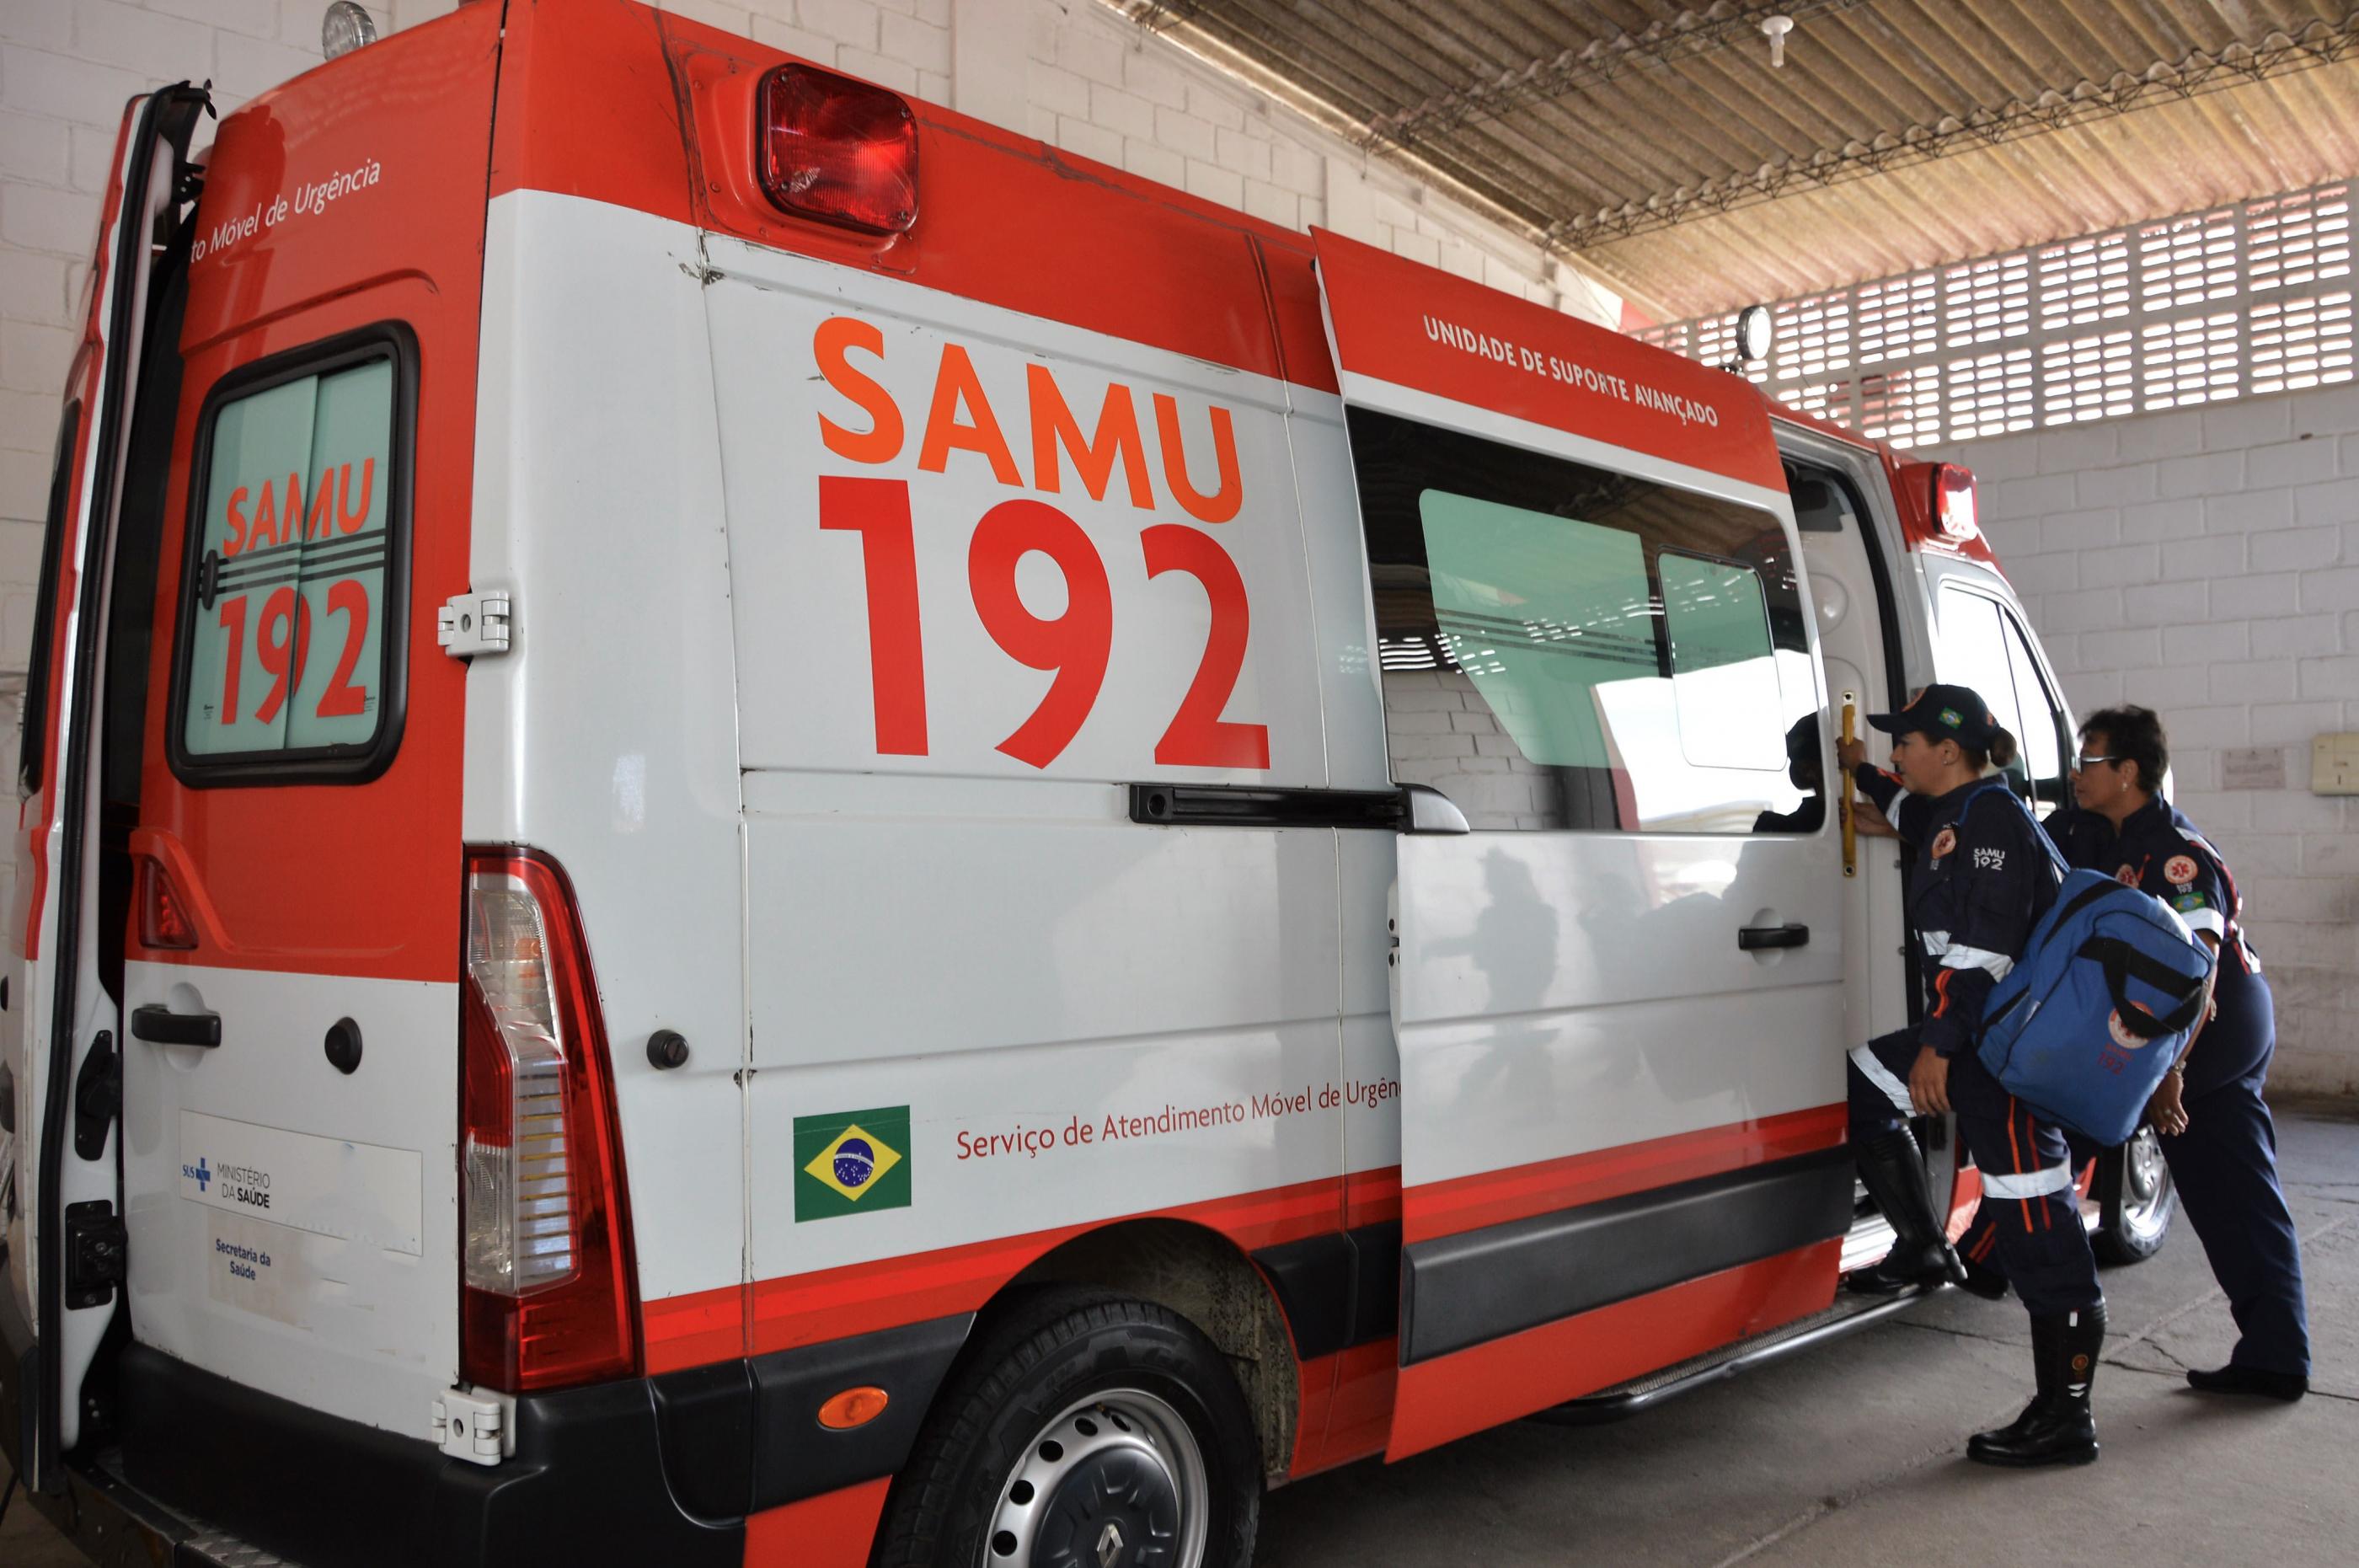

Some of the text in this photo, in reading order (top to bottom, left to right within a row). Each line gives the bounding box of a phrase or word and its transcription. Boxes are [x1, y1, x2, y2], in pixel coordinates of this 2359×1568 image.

[211, 203, 261, 254] Móvel
[265, 194, 288, 227] de
[294, 158, 381, 215] Urgência
[1423, 314, 1719, 426] UNIDADE DE SUPORTE AVANÇADO
[813, 316, 1243, 524] SAMU
[222, 458, 375, 558] SAMU
[819, 474, 1270, 769] 192
[219, 579, 369, 725] 192
[1974, 848, 2005, 859] SAMU
[1974, 856, 2003, 871] 192
[957, 1077, 1401, 1159] Serviço de Atendimento Móvel de Urgên
[182, 1164, 195, 1179] SUS
[217, 1162, 270, 1190] MINISTÉRIO
[222, 1183, 270, 1209] DA SAÚDE
[216, 1239, 271, 1267] Secretaria da
[230, 1260, 256, 1281] Saúde
